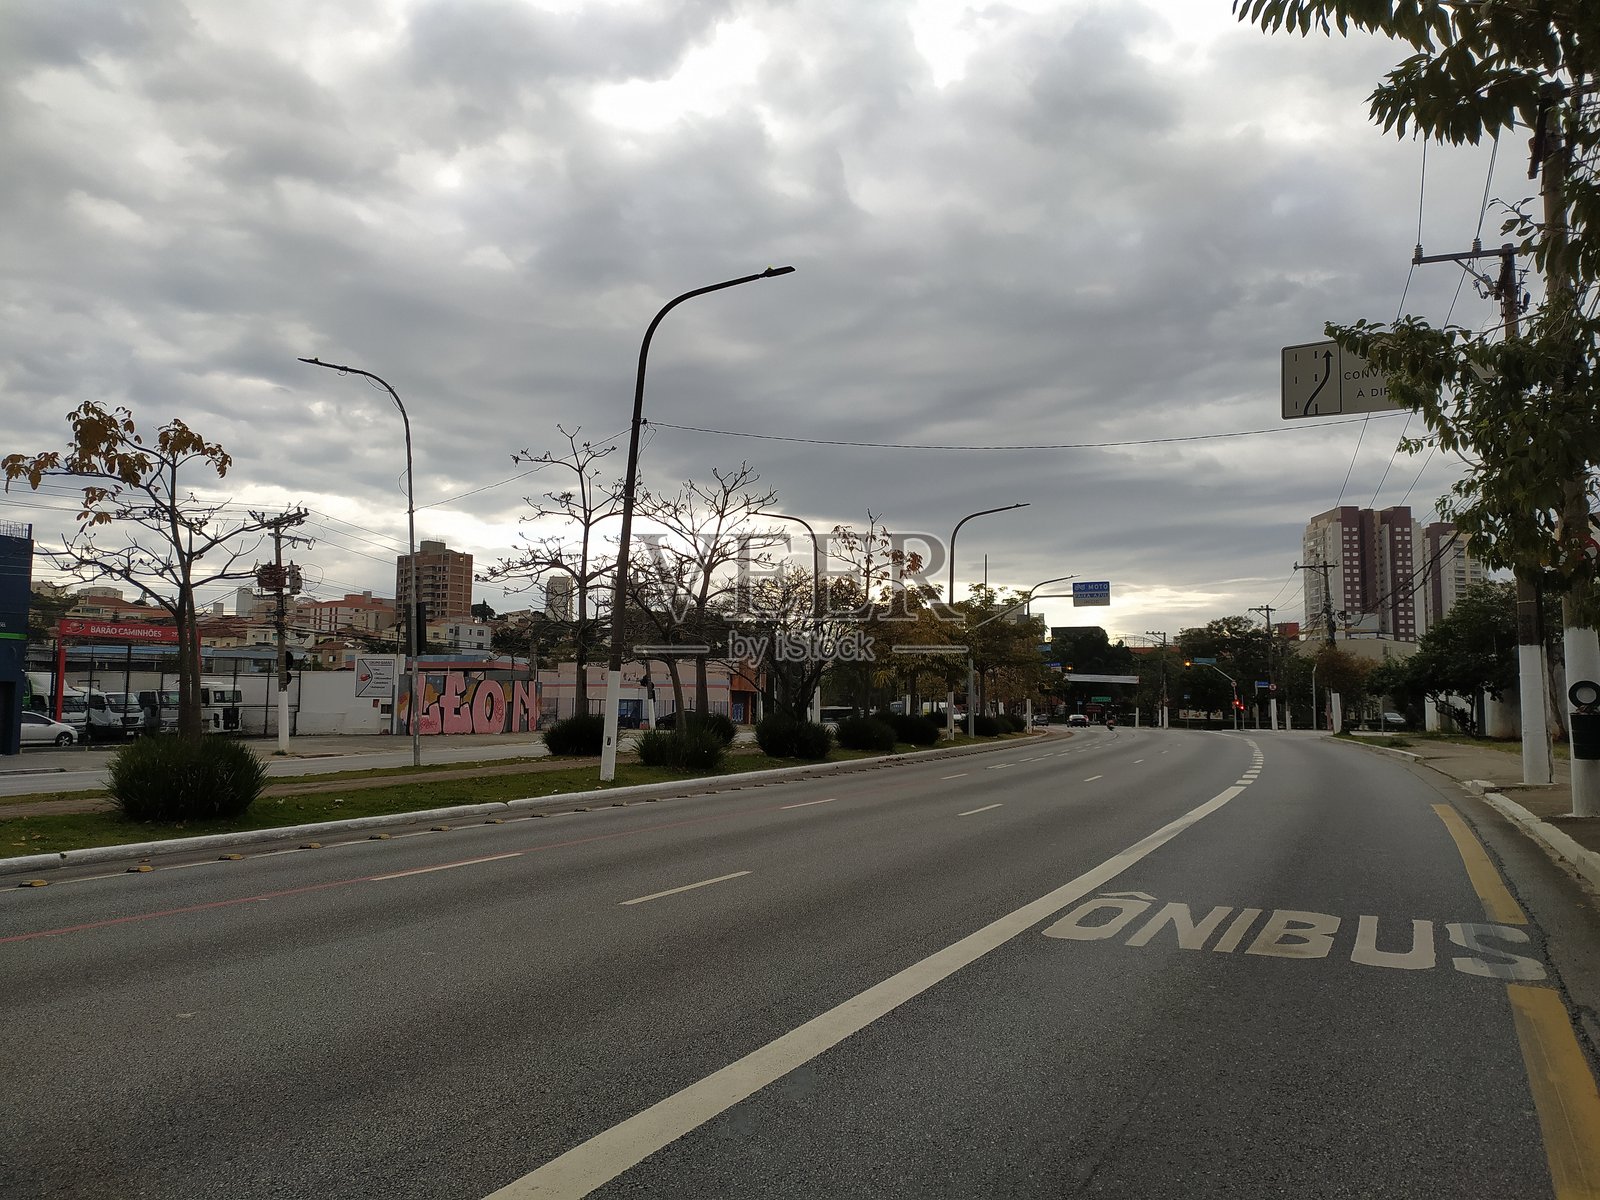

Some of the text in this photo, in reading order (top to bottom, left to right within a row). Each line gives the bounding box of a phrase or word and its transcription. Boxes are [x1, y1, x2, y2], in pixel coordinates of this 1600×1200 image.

[1356, 386, 1391, 398] À DIR
[90, 625, 117, 635] BARÃO
[118, 627, 162, 637] CAMINHÕES
[1041, 891, 1547, 980] ÔNIBUS
